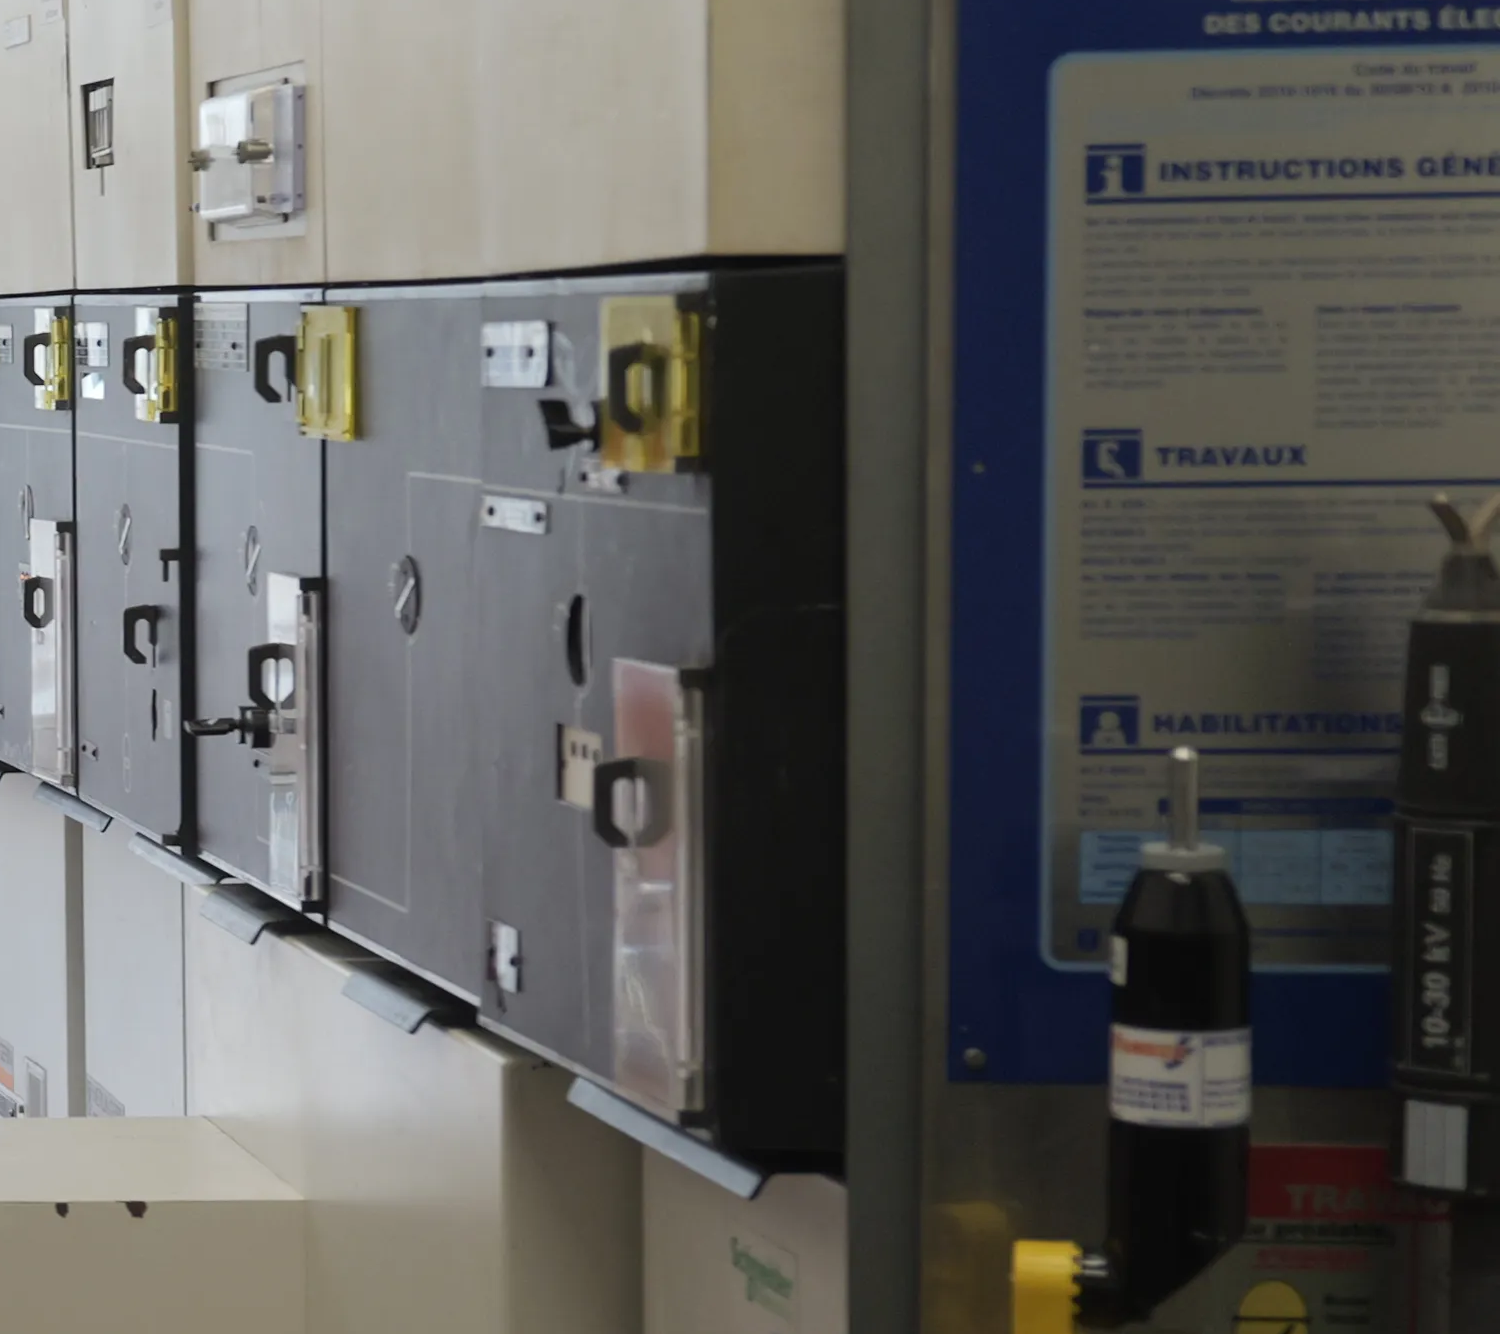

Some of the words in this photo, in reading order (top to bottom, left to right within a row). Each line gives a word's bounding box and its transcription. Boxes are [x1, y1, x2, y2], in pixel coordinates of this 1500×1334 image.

[1203, 12, 1261, 36] DES
[1268, 10, 1432, 33] COURANTS
[1159, 156, 1405, 182] INSTRUCTIONS
[1155, 443, 1309, 468] TRAVAUX
